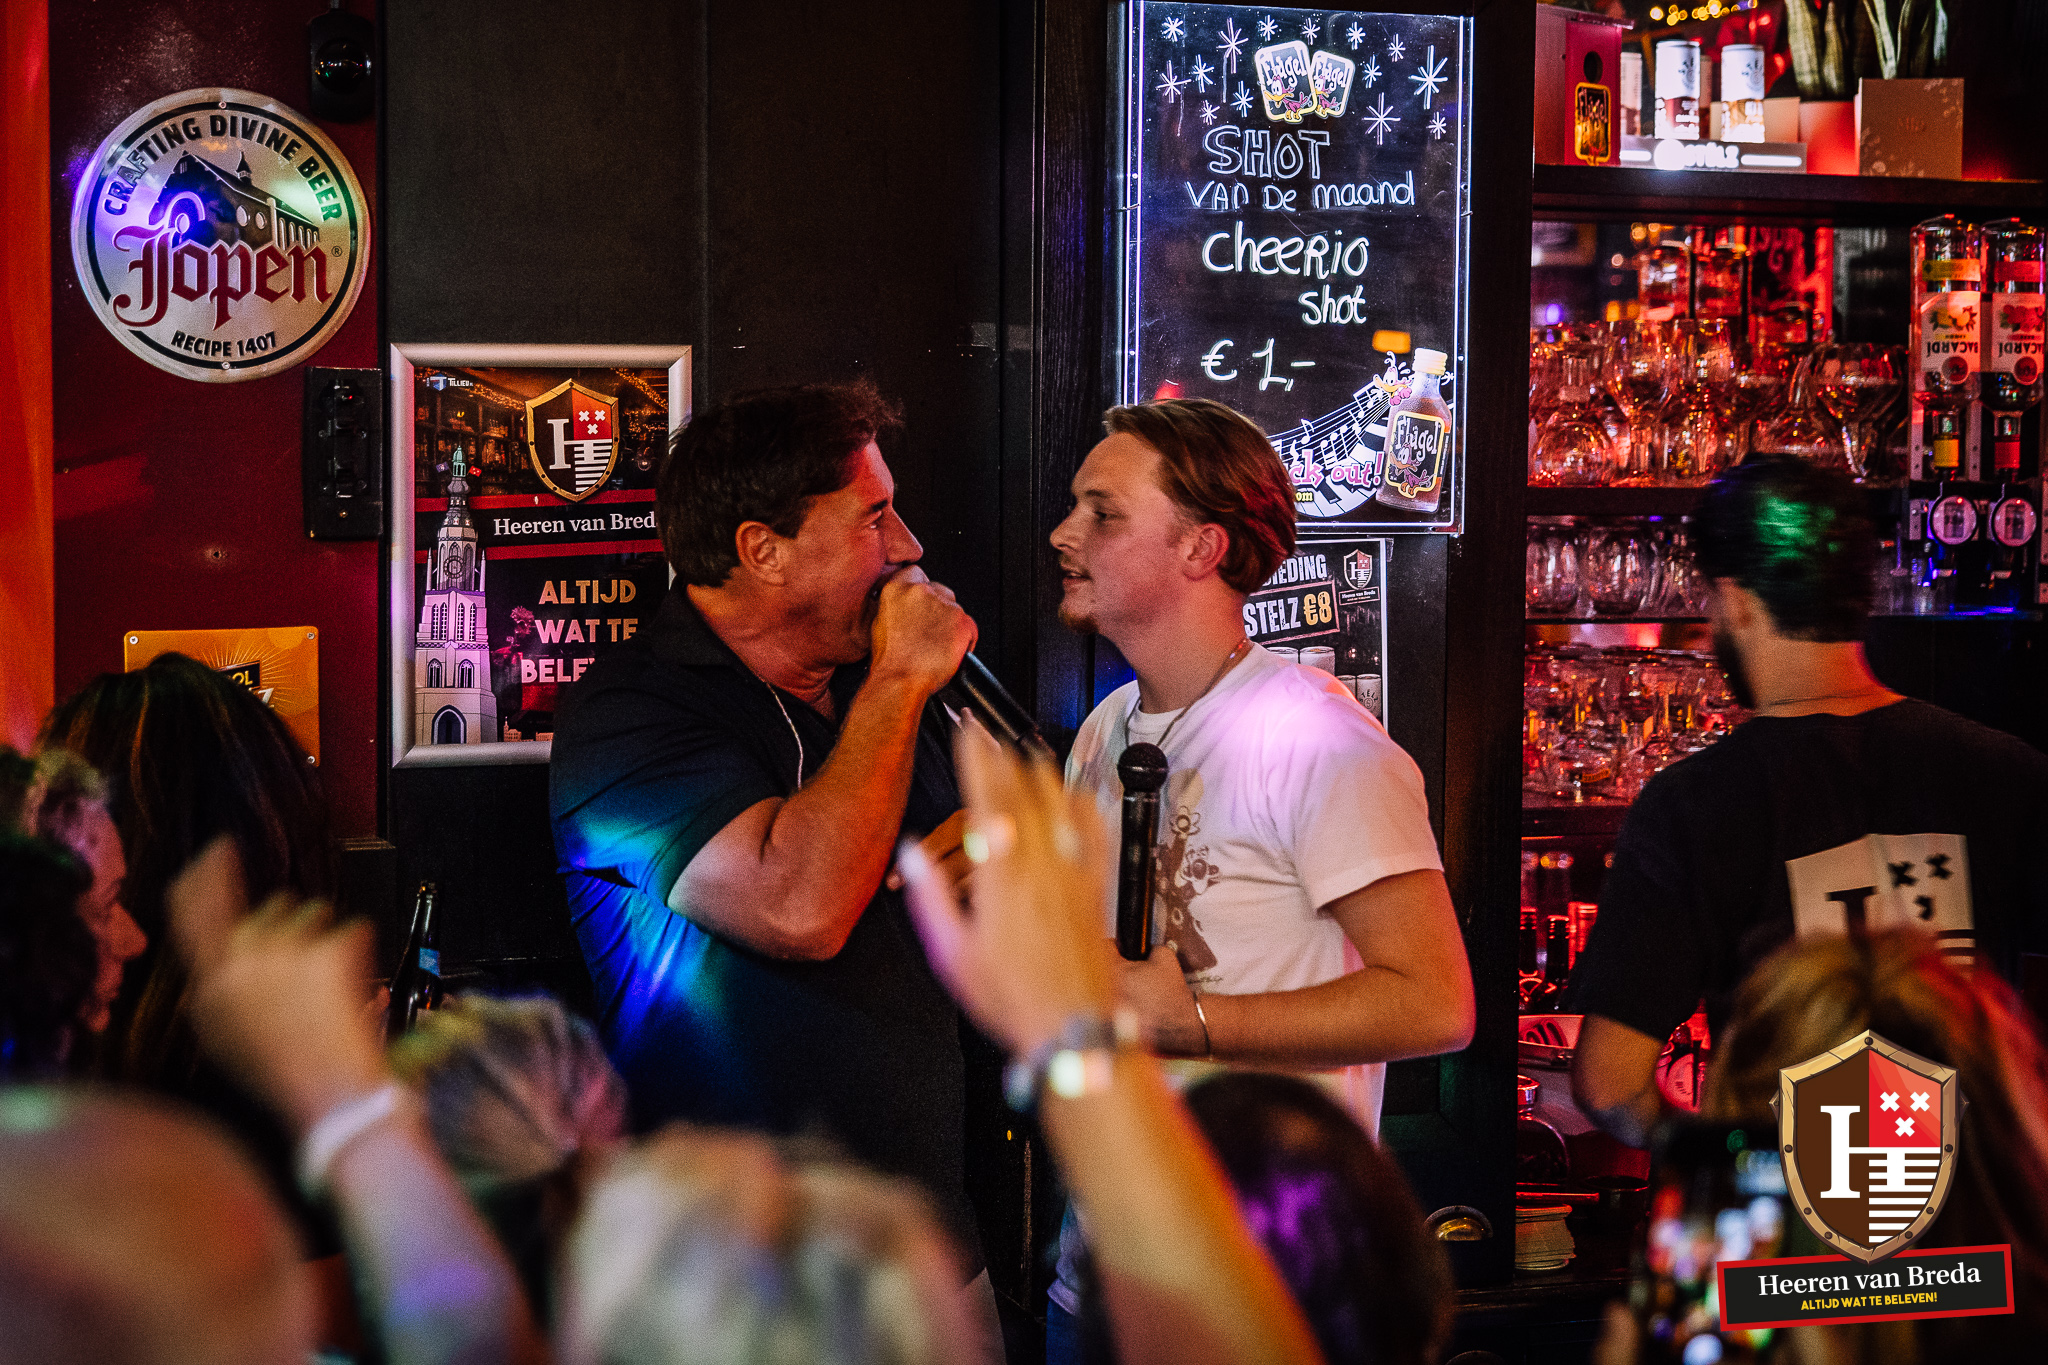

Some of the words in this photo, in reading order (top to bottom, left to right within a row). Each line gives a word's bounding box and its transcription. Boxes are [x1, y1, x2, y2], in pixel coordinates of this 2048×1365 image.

[1204, 125, 1330, 180] SHOT
[103, 117, 202, 216] CRAFTING
[210, 115, 302, 162] DIVINE
[296, 155, 343, 223] BEER
[1313, 170, 1415, 209] maand
[171, 331, 233, 357] RECIPE
[236, 331, 277, 356] 1407
[1289, 449, 1325, 487] ck
[1331, 450, 1384, 487] out!
[493, 519, 566, 536] Heeren
[569, 520, 606, 533] van
[610, 512, 657, 530] Bred
[539, 580, 637, 604] ALTIJD
[1303, 591, 1333, 626] €8
[535, 618, 601, 644] WAT
[607, 617, 638, 643] TE
[521, 658, 595, 684] BELE
